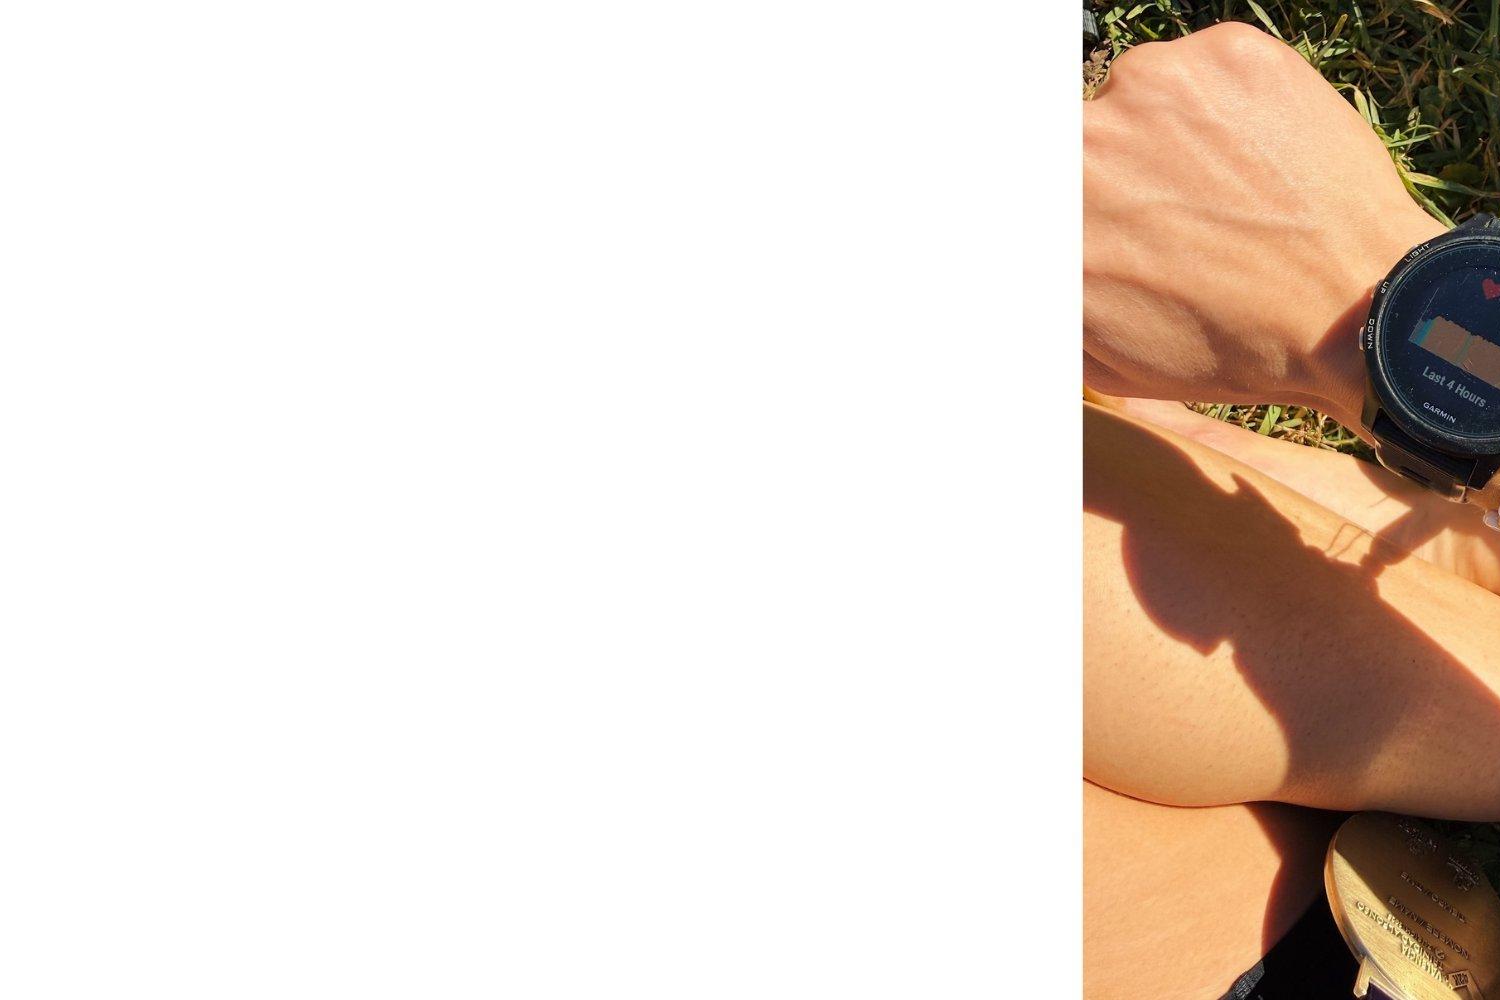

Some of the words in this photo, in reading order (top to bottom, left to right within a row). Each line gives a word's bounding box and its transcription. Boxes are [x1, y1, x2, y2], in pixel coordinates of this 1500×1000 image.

[1404, 242, 1430, 262] LIGHT
[1381, 281, 1389, 294] UP
[1367, 318, 1375, 349] DOWN
[1422, 366, 1446, 386] Last
[1446, 380, 1455, 390] 4
[1454, 383, 1487, 407] Hours
[1423, 402, 1457, 424] GARMIN
